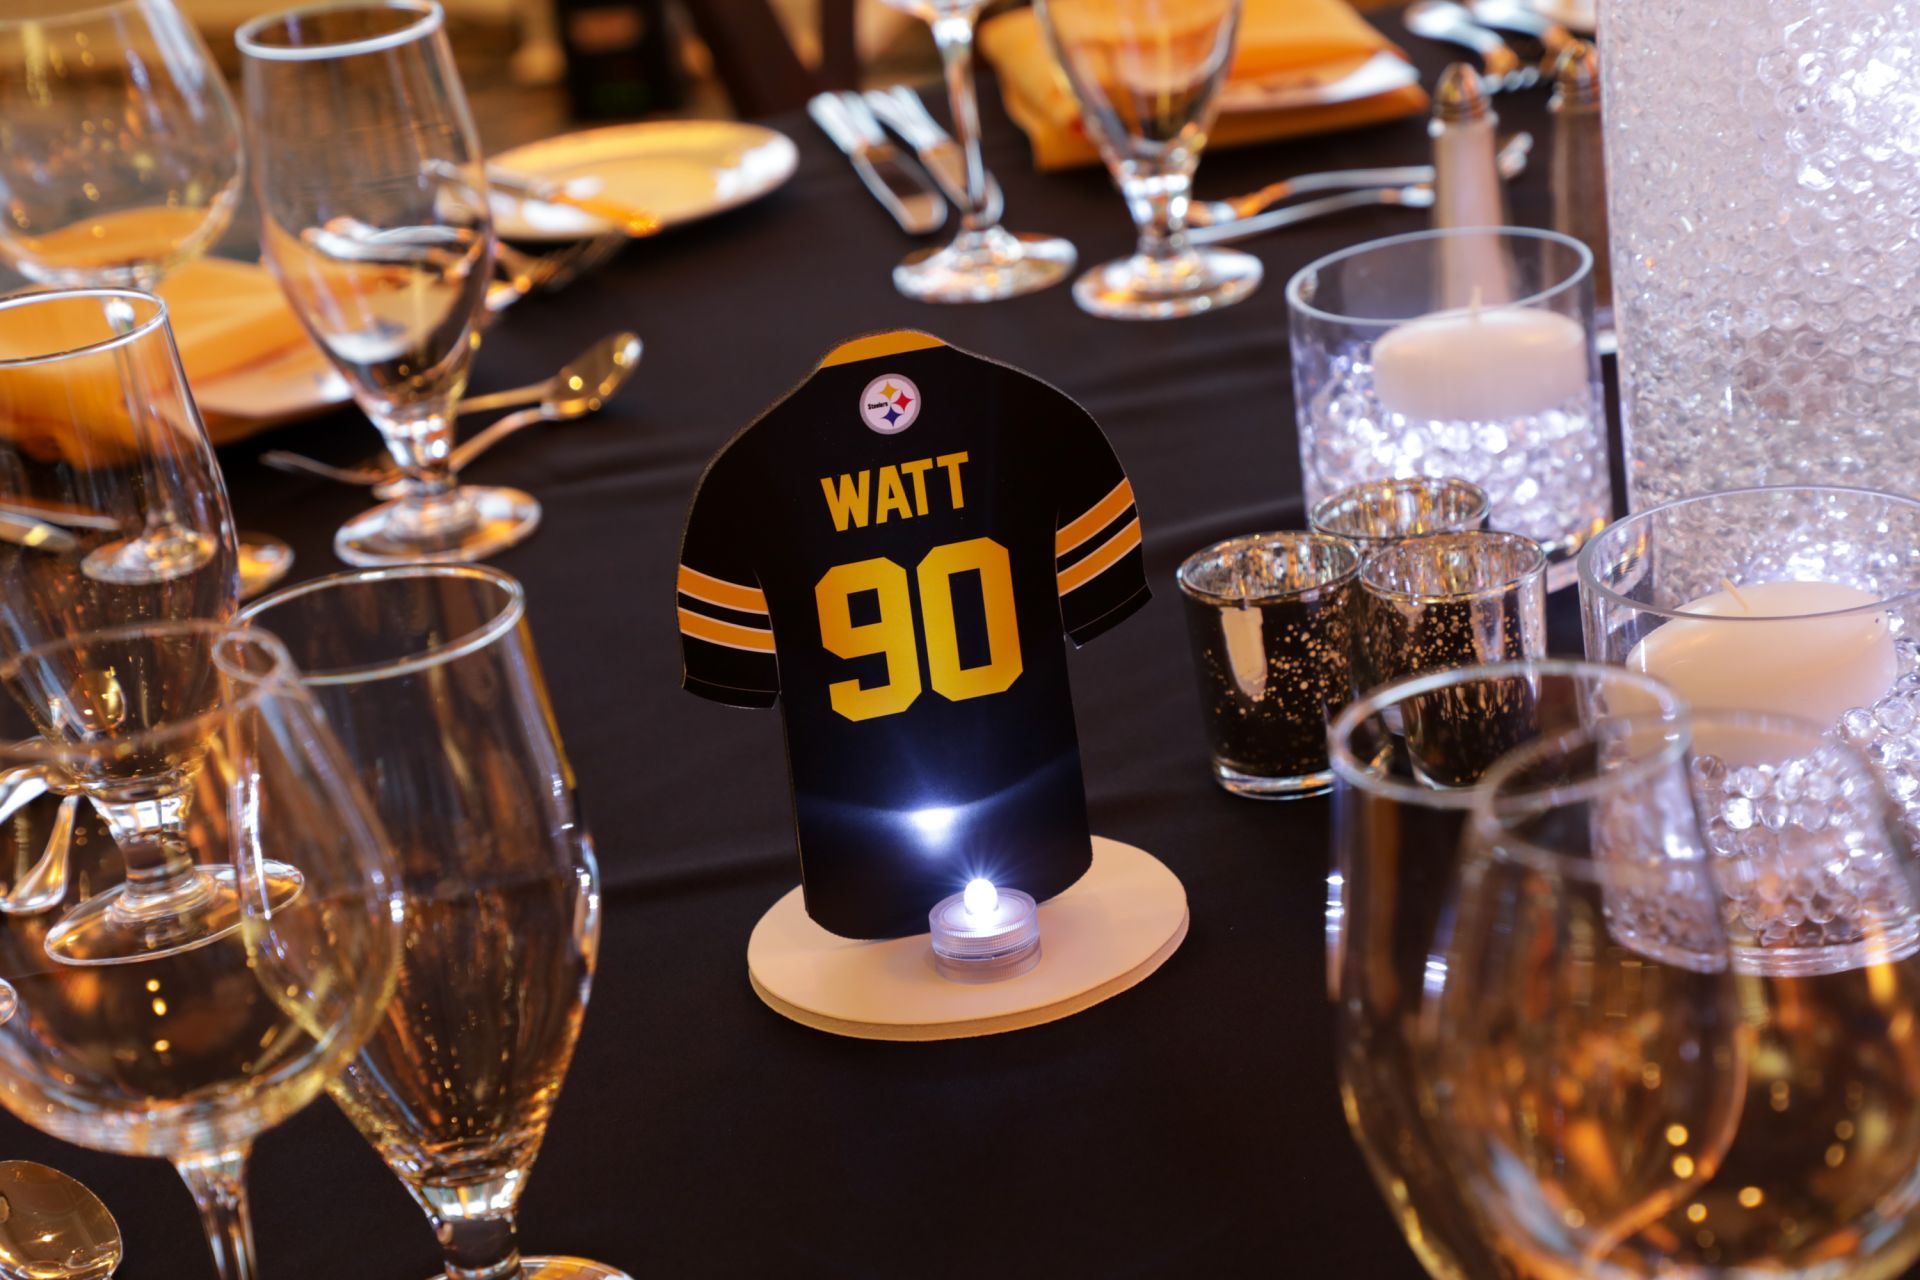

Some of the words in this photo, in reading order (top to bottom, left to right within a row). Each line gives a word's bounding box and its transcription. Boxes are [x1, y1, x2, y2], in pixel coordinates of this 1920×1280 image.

[867, 401, 889, 410] Steelers
[820, 451, 969, 532] WATT
[814, 536, 1024, 722] 90
